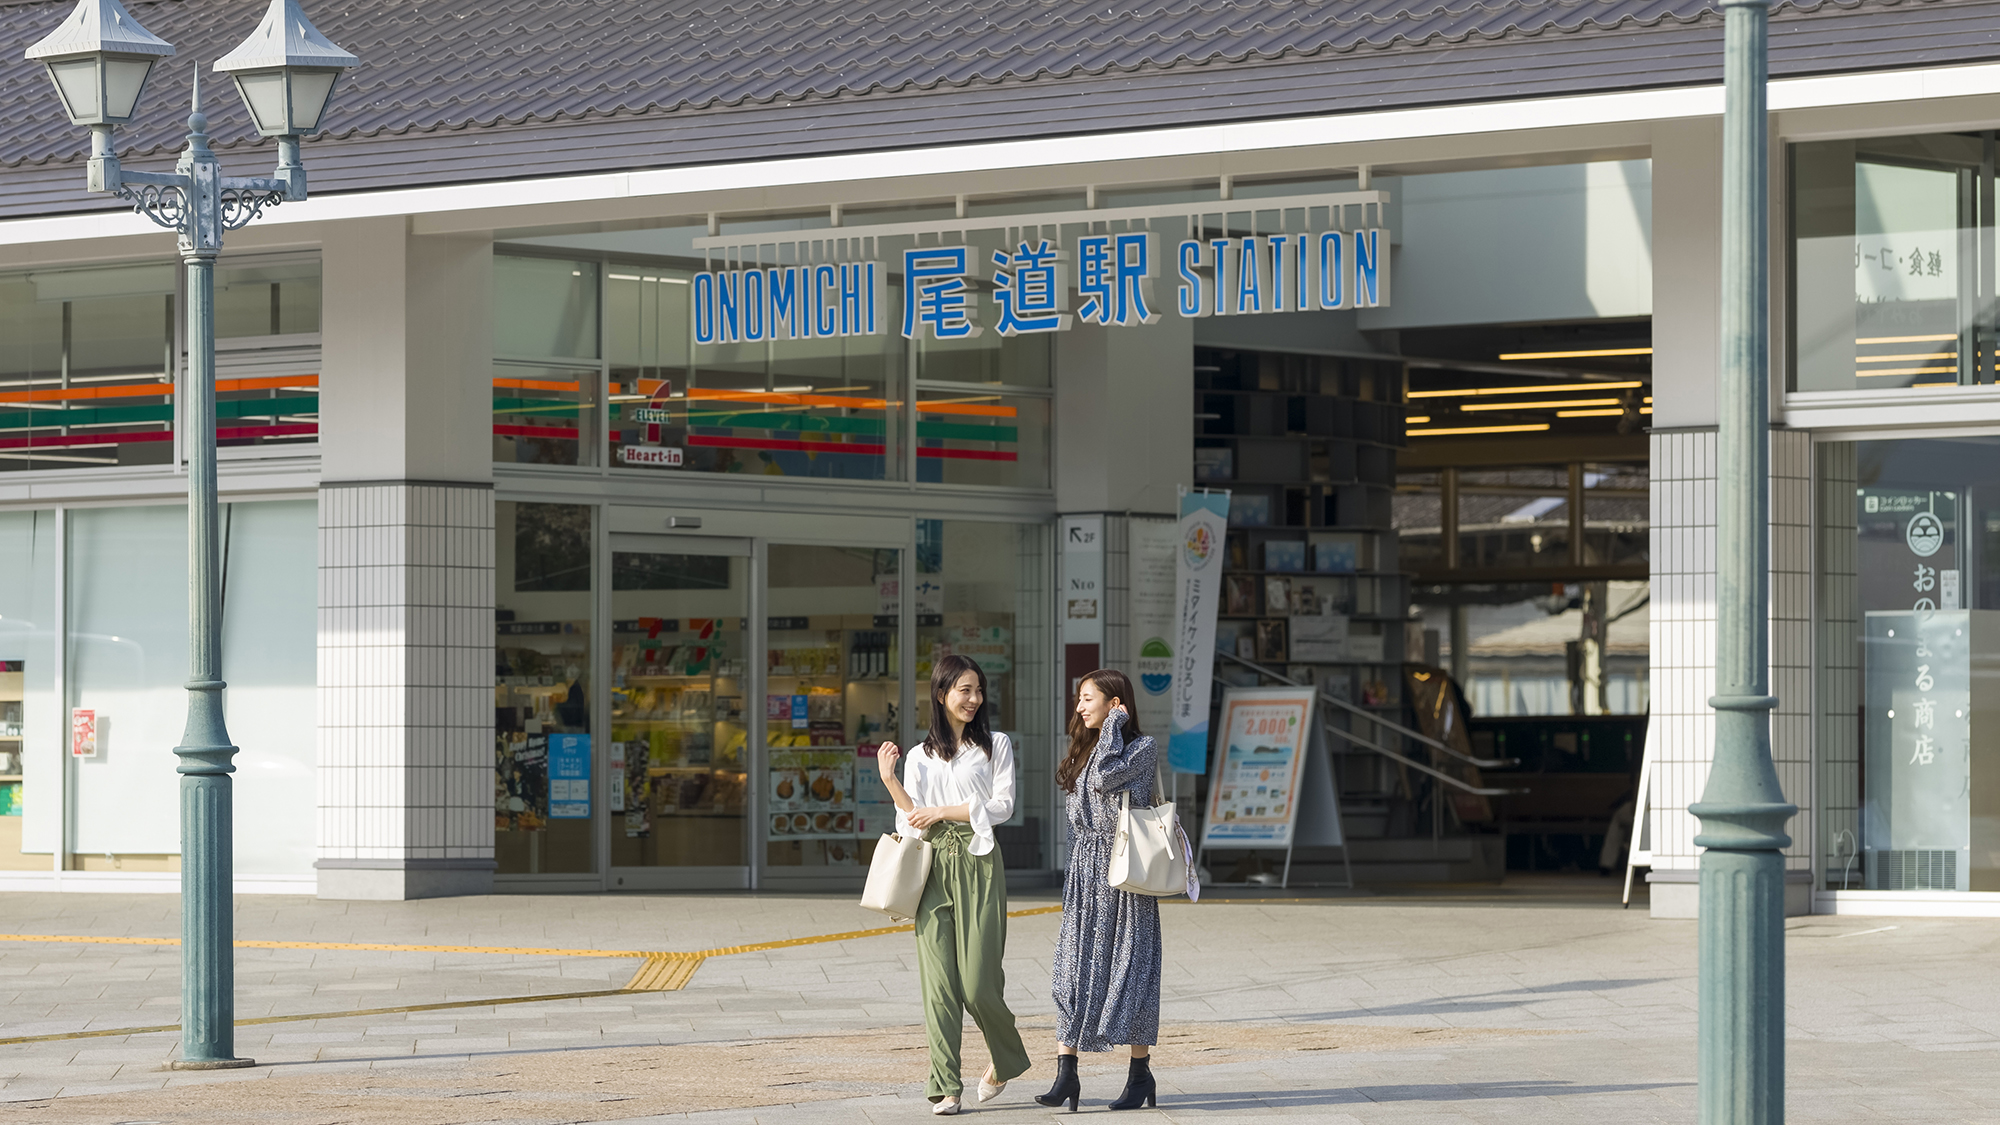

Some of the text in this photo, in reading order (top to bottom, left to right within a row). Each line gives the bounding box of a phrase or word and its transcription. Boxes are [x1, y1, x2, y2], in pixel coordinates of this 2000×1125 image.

[694, 262, 879, 344] ONOMICHI
[901, 233, 1154, 339] 尾道駅
[1178, 228, 1382, 318] STATION
[626, 448, 681, 464] Heart-in
[1083, 533, 1095, 543] 2F
[1179, 578, 1202, 718] ミタイケンひろしま
[1909, 564, 1936, 766] おのまる商店
[1245, 718, 1287, 736] 2,000
